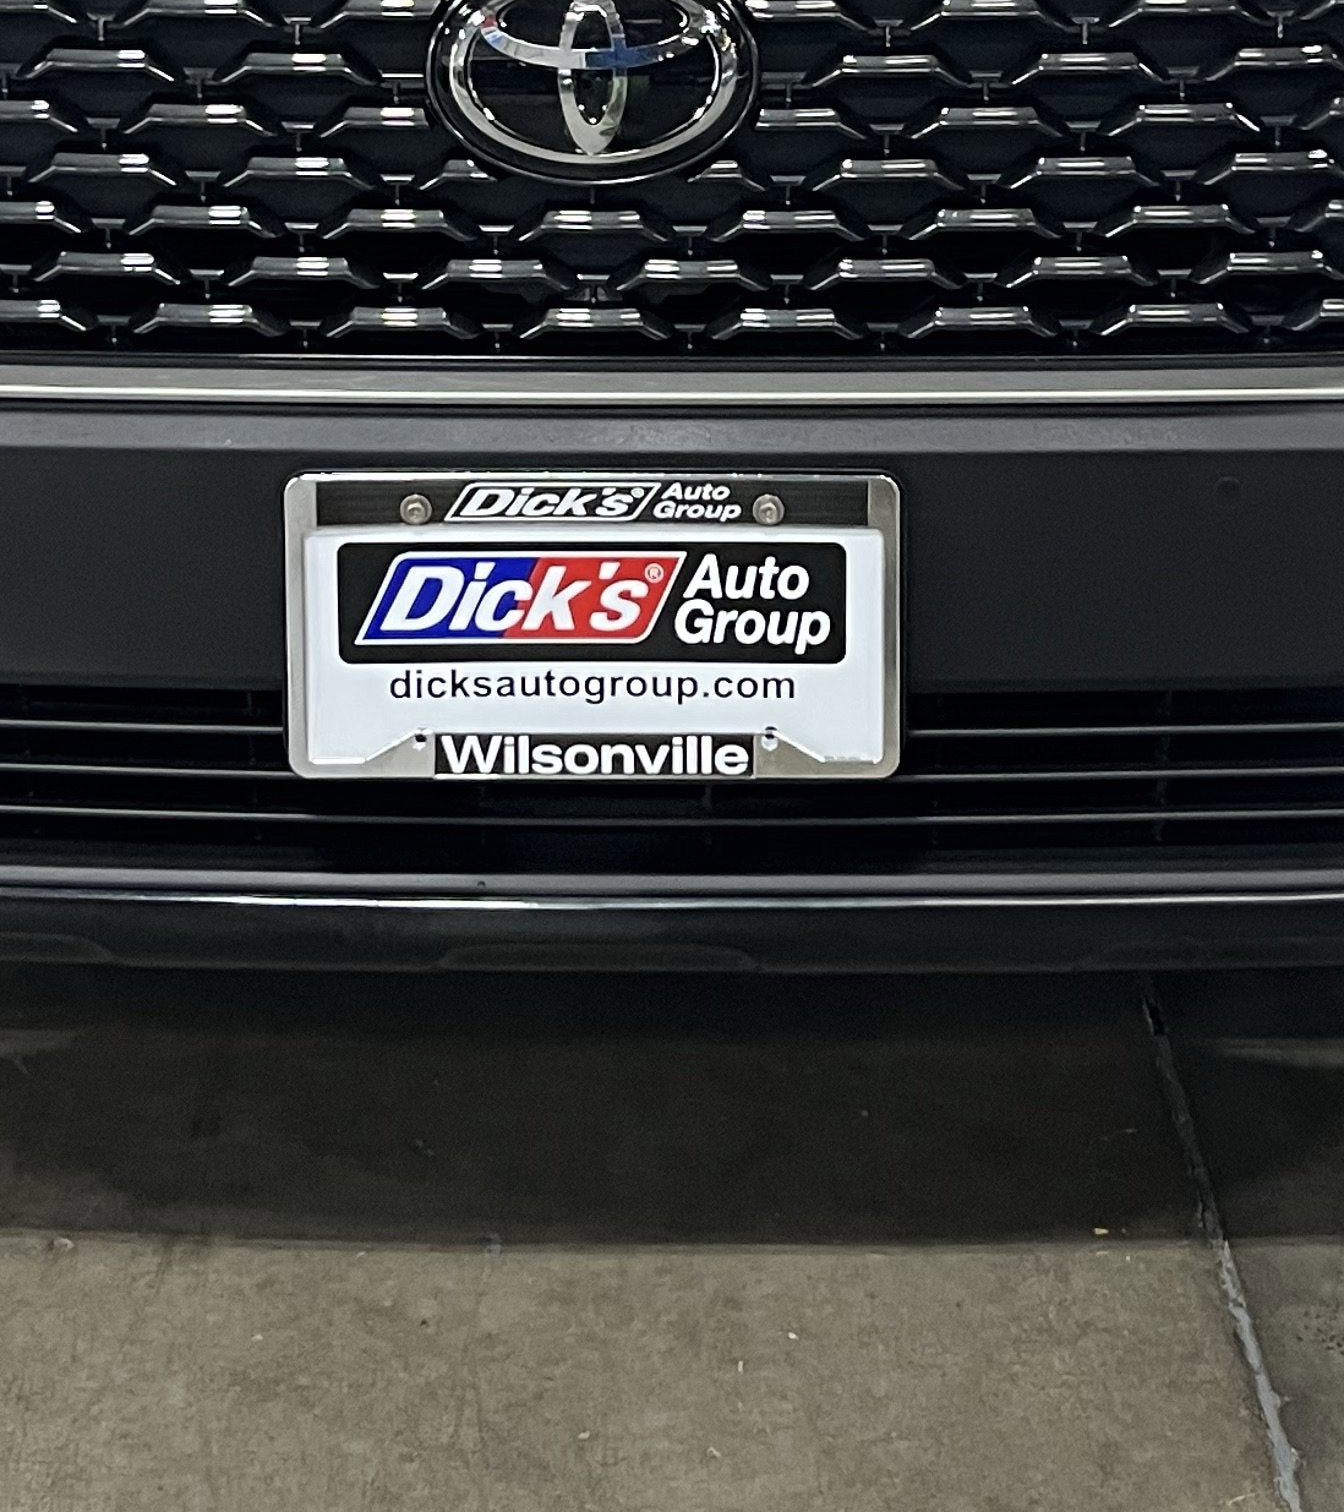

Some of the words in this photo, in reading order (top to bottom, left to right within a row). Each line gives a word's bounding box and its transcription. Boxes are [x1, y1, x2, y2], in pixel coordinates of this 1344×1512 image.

[459, 487, 635, 518] Dick's
[653, 500, 742, 522] Group
[661, 482, 731, 502] Auto
[682, 553, 810, 601] Auto
[380, 560, 649, 633] Dick's
[674, 598, 831, 655] Group
[389, 670, 796, 705] dicksautogroup.com
[441, 734, 750, 775] Wilsonville
